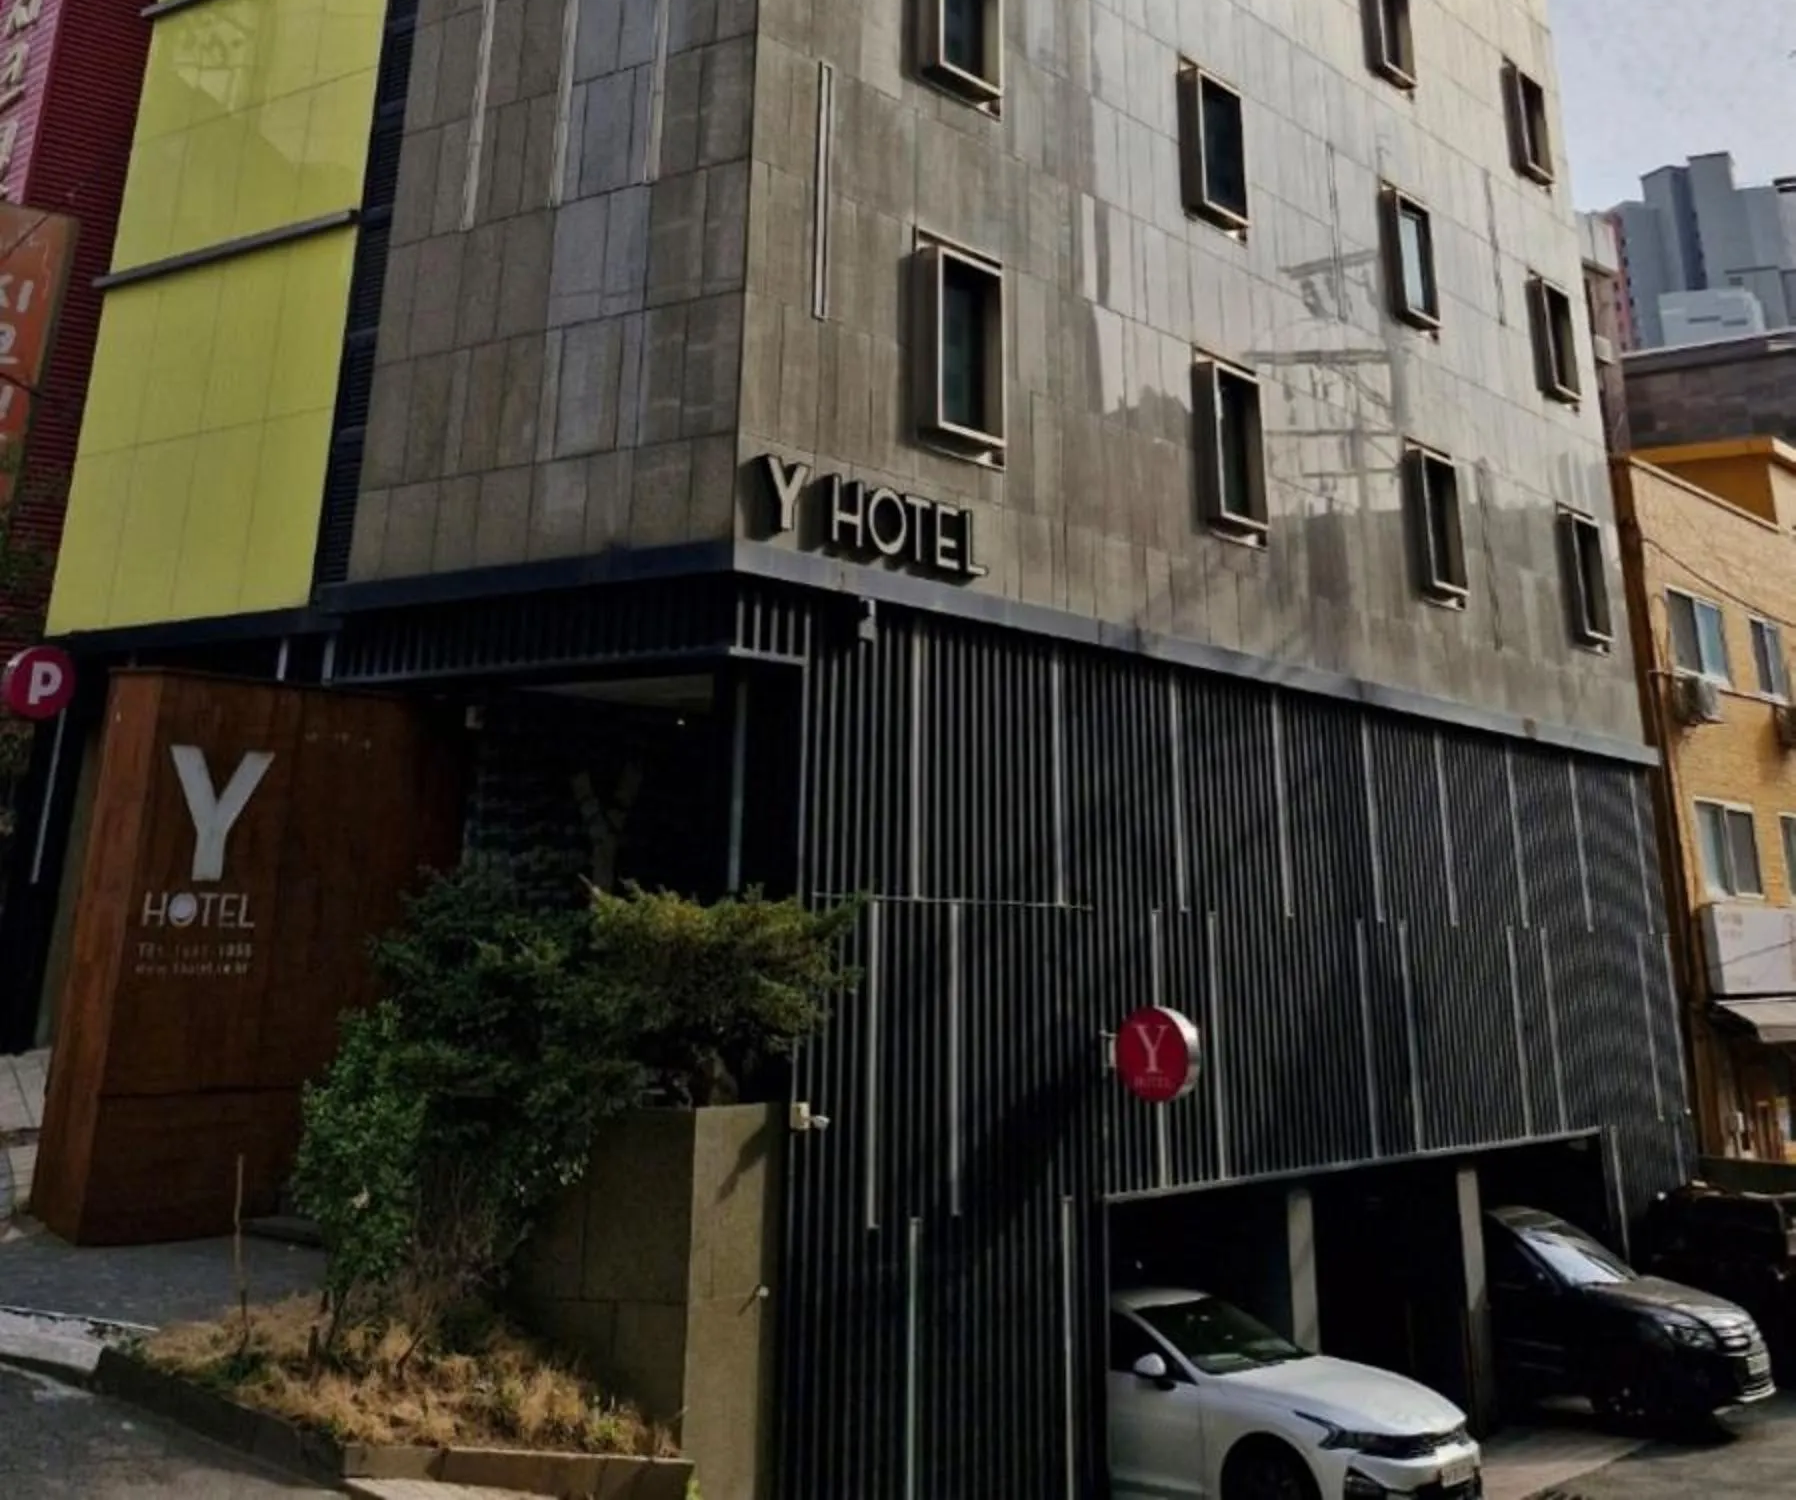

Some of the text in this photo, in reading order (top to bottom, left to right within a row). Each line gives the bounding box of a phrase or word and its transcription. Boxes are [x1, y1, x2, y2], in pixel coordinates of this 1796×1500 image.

[768, 455, 988, 576] Y HOTEL
[28, 660, 63, 705] P
[171, 743, 275, 882] Y
[141, 890, 256, 929] HOTEL
[1132, 1023, 1169, 1074] Y
